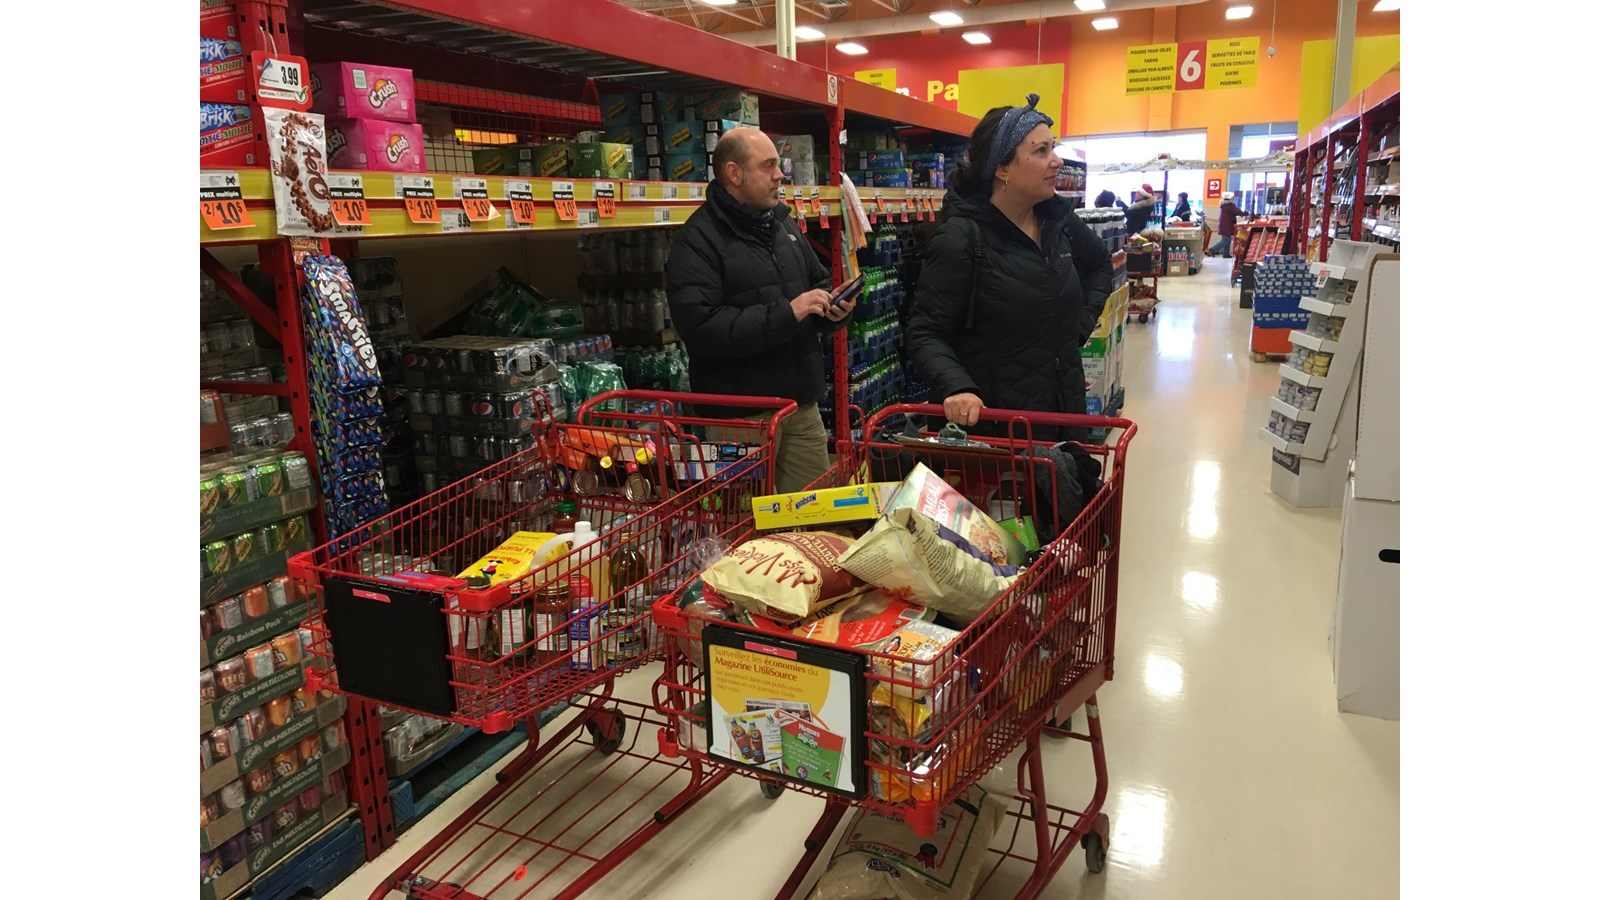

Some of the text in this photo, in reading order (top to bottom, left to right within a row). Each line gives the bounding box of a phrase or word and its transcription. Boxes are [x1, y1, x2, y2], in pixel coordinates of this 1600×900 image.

[200, 43, 225, 61] risk
[281, 66, 299, 86] 3.99
[1180, 49, 1201, 82] 6
[369, 80, 398, 108] Crush
[326, 130, 346, 152] ush
[387, 134, 410, 163] Crush
[923, 483, 941, 519] TMEAL
[934, 499, 951, 526] RISP
[776, 559, 817, 589] Miss
[215, 635, 236, 658] Crush
[237, 626, 265, 642] Rainbow
[714, 647, 818, 677] Surveillez les économies du
[715, 657, 798, 682] Magazine UtiliSource
[219, 694, 241, 719] Crush
[242, 744, 263, 768] Crush
[248, 795, 267, 819] Crush
